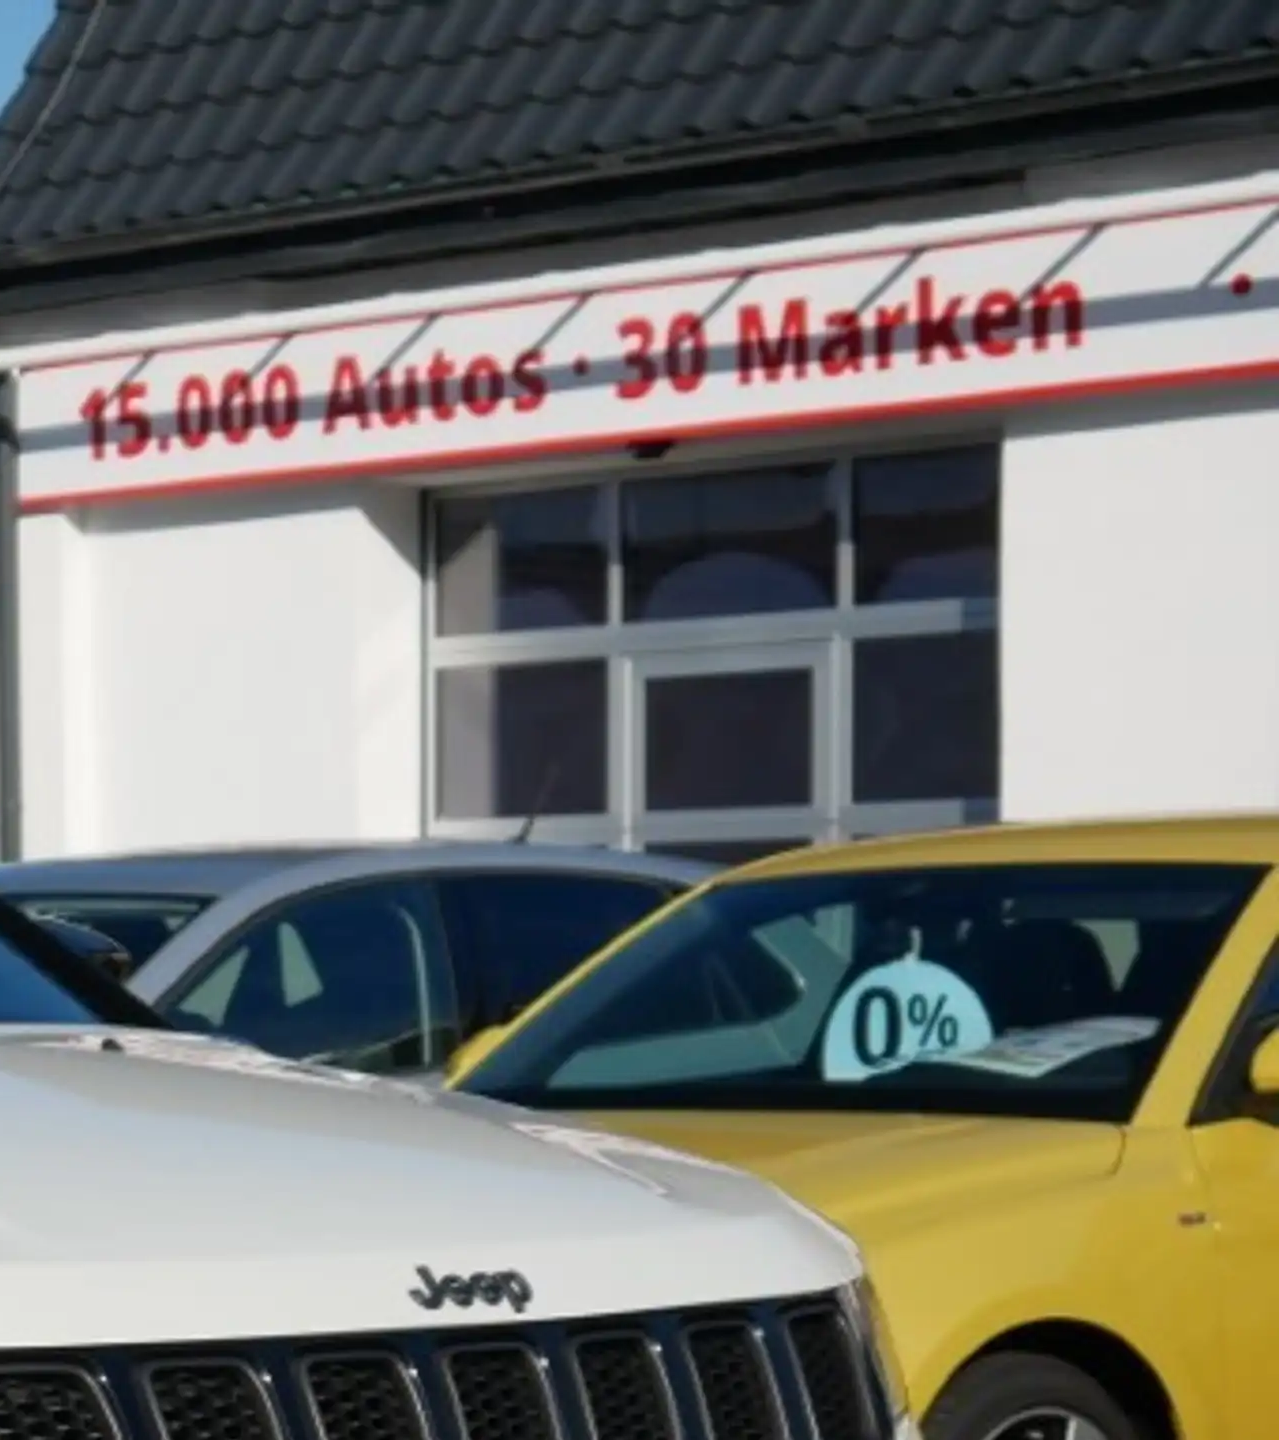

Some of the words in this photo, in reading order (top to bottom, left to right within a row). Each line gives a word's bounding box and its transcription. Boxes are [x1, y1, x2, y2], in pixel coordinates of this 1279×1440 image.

[81, 363, 299, 460] 15.000
[323, 347, 547, 436] Autos
[616, 312, 707, 401] 30
[738, 277, 1084, 386] Marken
[853, 985, 959, 1067] 0%
[409, 1264, 533, 1313] Jeep
